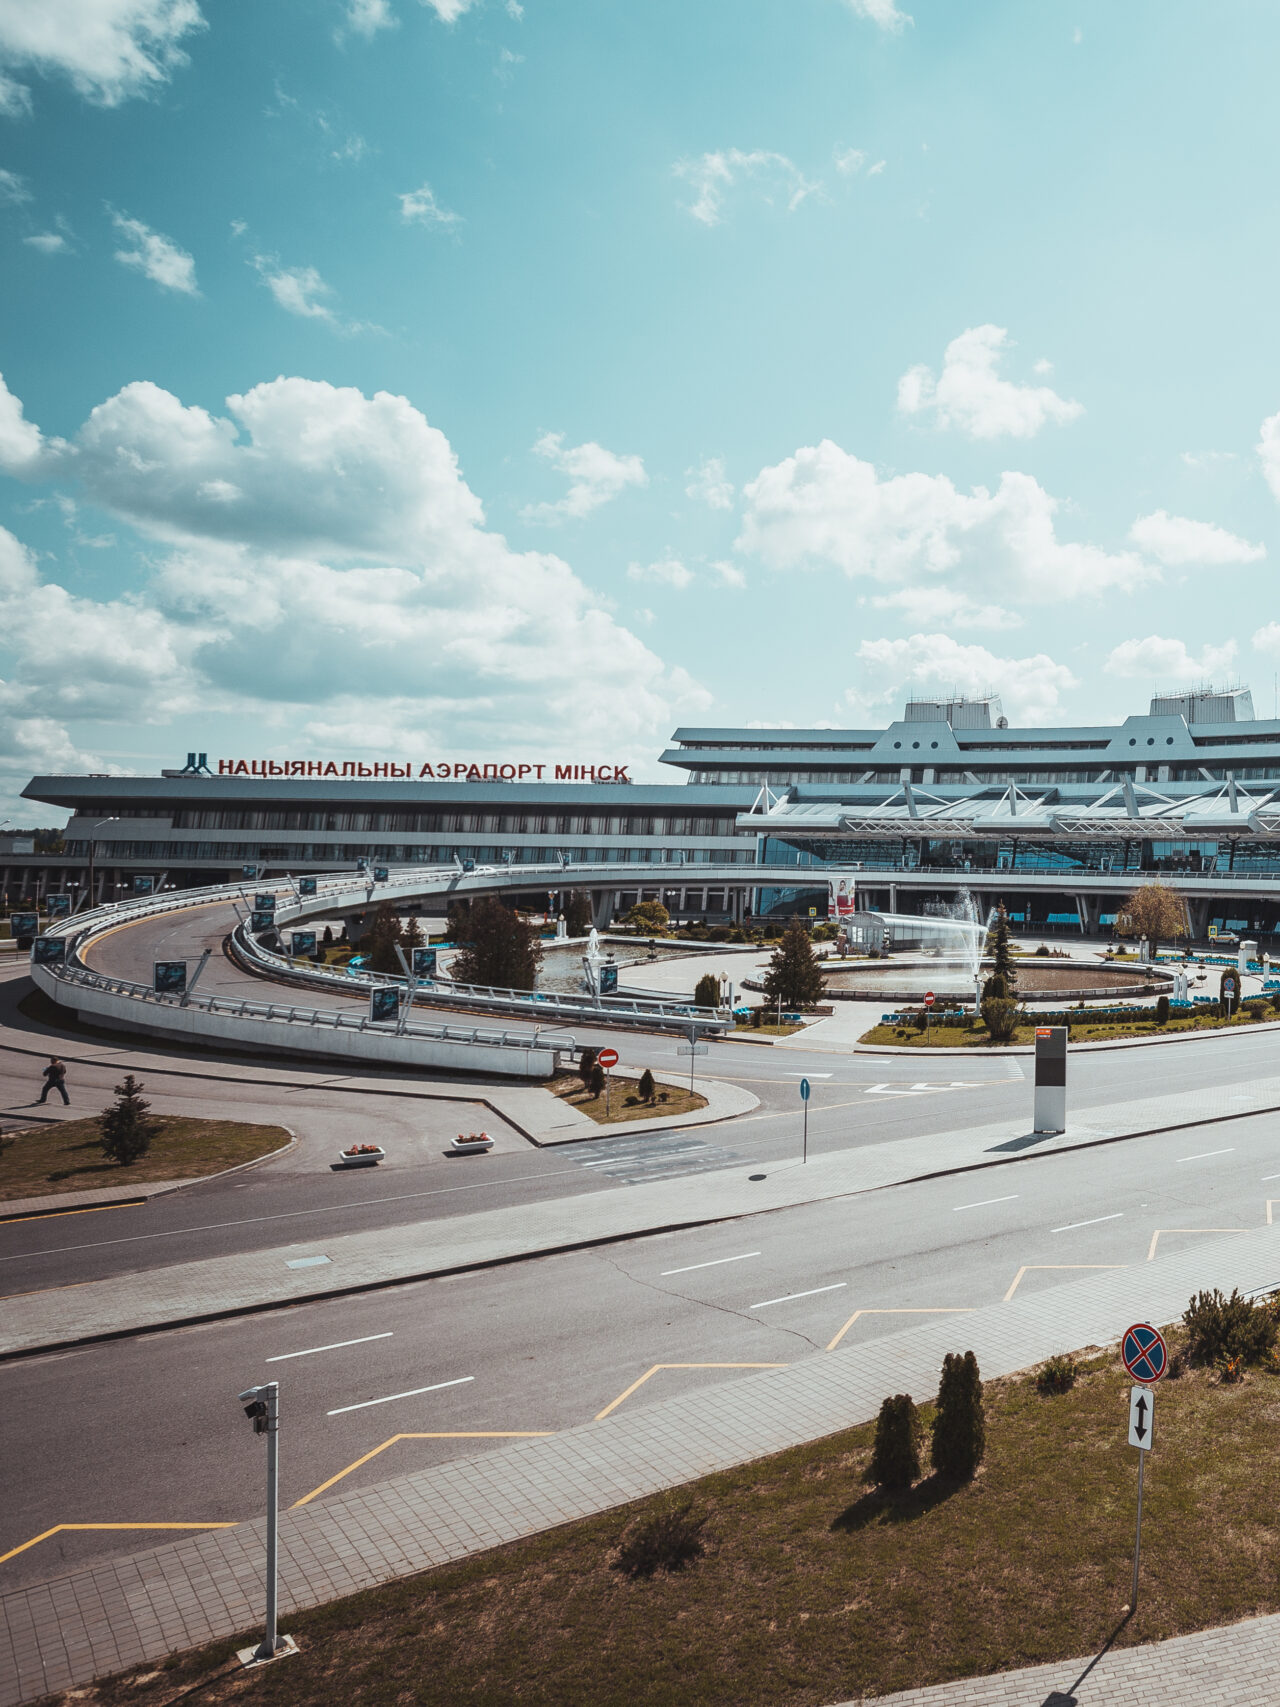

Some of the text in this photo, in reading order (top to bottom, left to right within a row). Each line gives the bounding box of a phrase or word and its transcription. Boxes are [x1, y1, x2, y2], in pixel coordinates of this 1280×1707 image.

[218, 759, 630, 781] НАЦЫЯНАЛЬНЫ АЭРАПОРТ МІНСК
